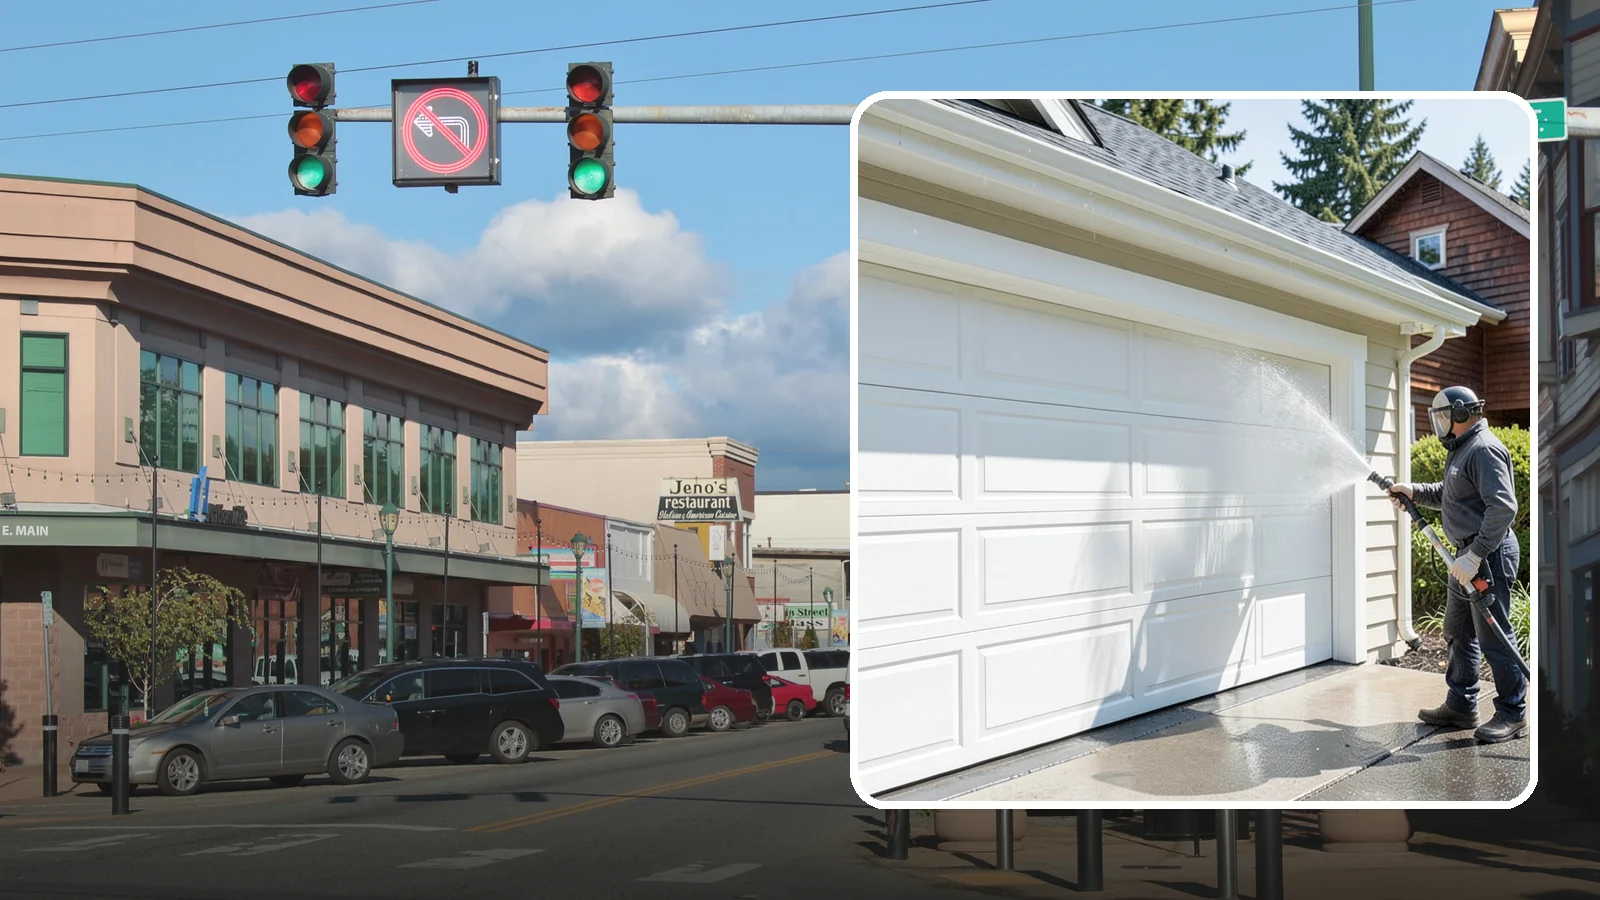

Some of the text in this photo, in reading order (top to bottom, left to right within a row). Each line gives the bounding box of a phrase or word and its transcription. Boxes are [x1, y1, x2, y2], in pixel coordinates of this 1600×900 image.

[670, 480, 727, 494] Jeno's
[665, 496, 731, 509] restaurant
[659, 510, 682, 520] Italian
[686, 510, 714, 519] American
[715, 509, 737, 519] Cuisine
[2, 525, 49, 536] E. MAIN
[797, 607, 828, 617] Street
